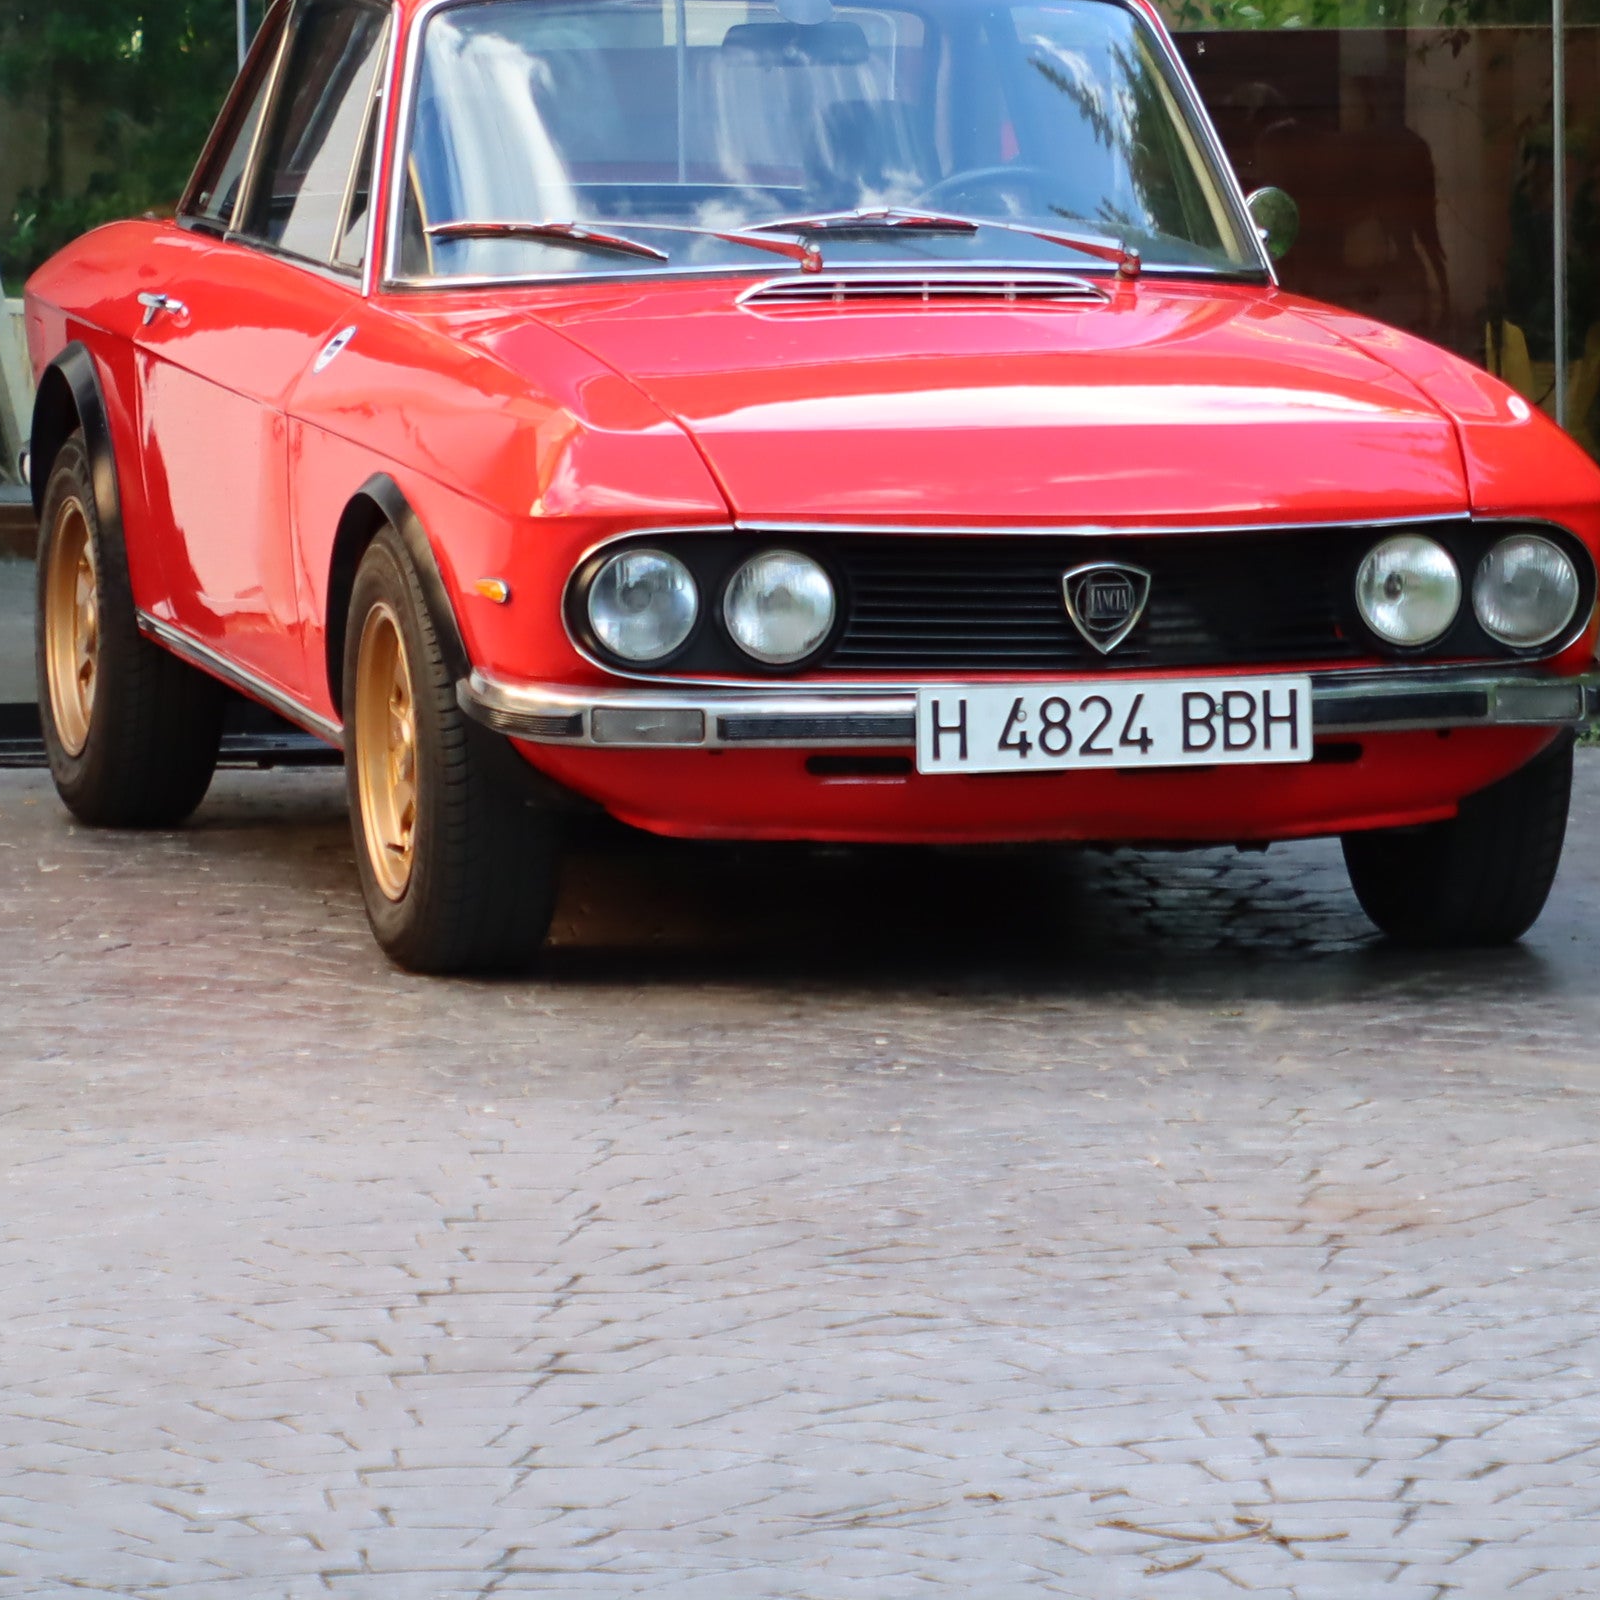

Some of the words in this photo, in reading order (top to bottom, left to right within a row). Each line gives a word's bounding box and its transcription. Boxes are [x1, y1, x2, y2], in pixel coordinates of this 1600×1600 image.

[931, 699, 968, 761] H
[997, 693, 1154, 758] 4824
[1181, 687, 1299, 754] BBH
